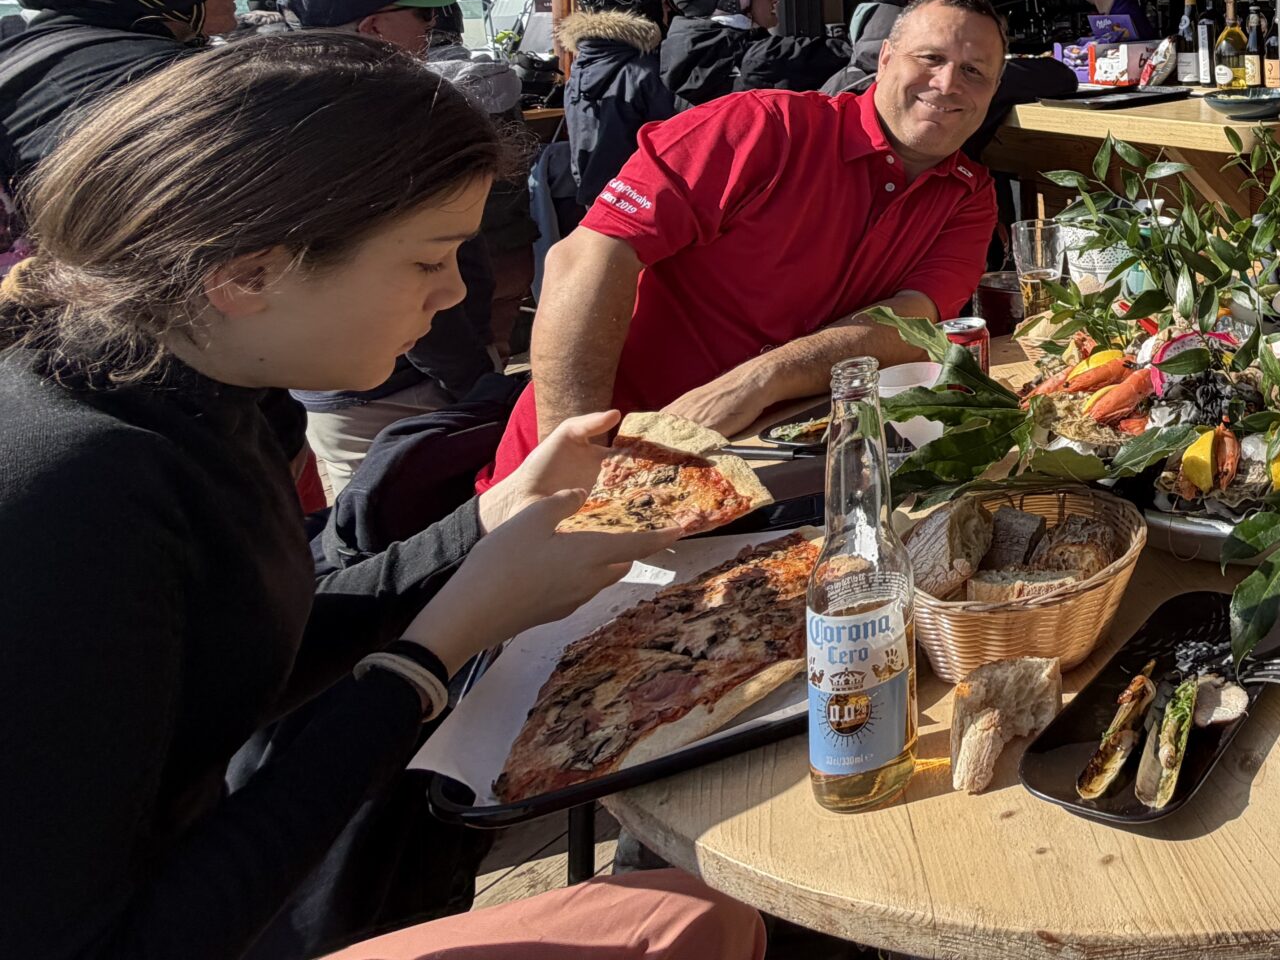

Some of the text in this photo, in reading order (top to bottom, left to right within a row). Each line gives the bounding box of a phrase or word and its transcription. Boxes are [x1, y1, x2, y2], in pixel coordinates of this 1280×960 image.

[616, 199, 637, 214] 2019
[809, 615, 891, 649] Corona
[828, 646, 868, 665] Cero
